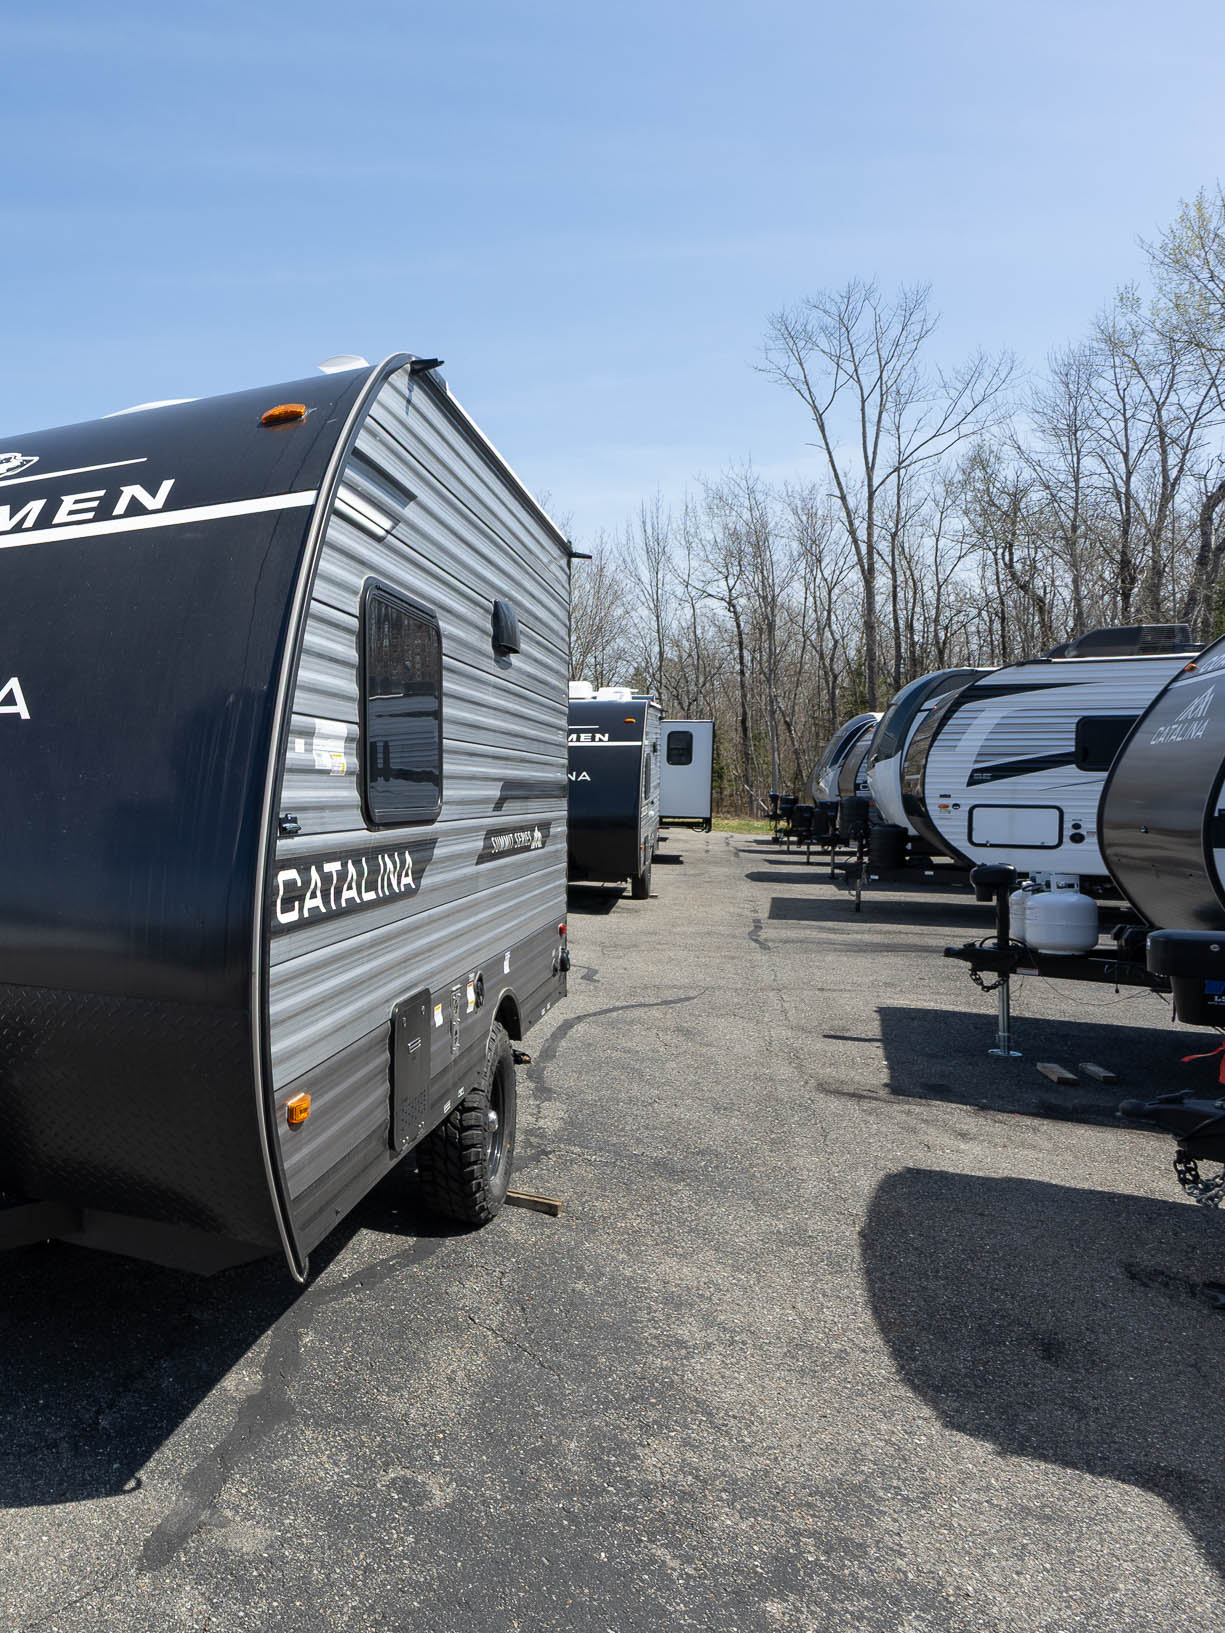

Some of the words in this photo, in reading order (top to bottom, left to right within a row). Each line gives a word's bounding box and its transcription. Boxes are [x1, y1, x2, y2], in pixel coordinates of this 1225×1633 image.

[1150, 719, 1209, 745] CATALINA
[491, 833, 513, 853] SUMMIT
[514, 831, 532, 848] SERIES
[276, 850, 416, 924] CATALINA
